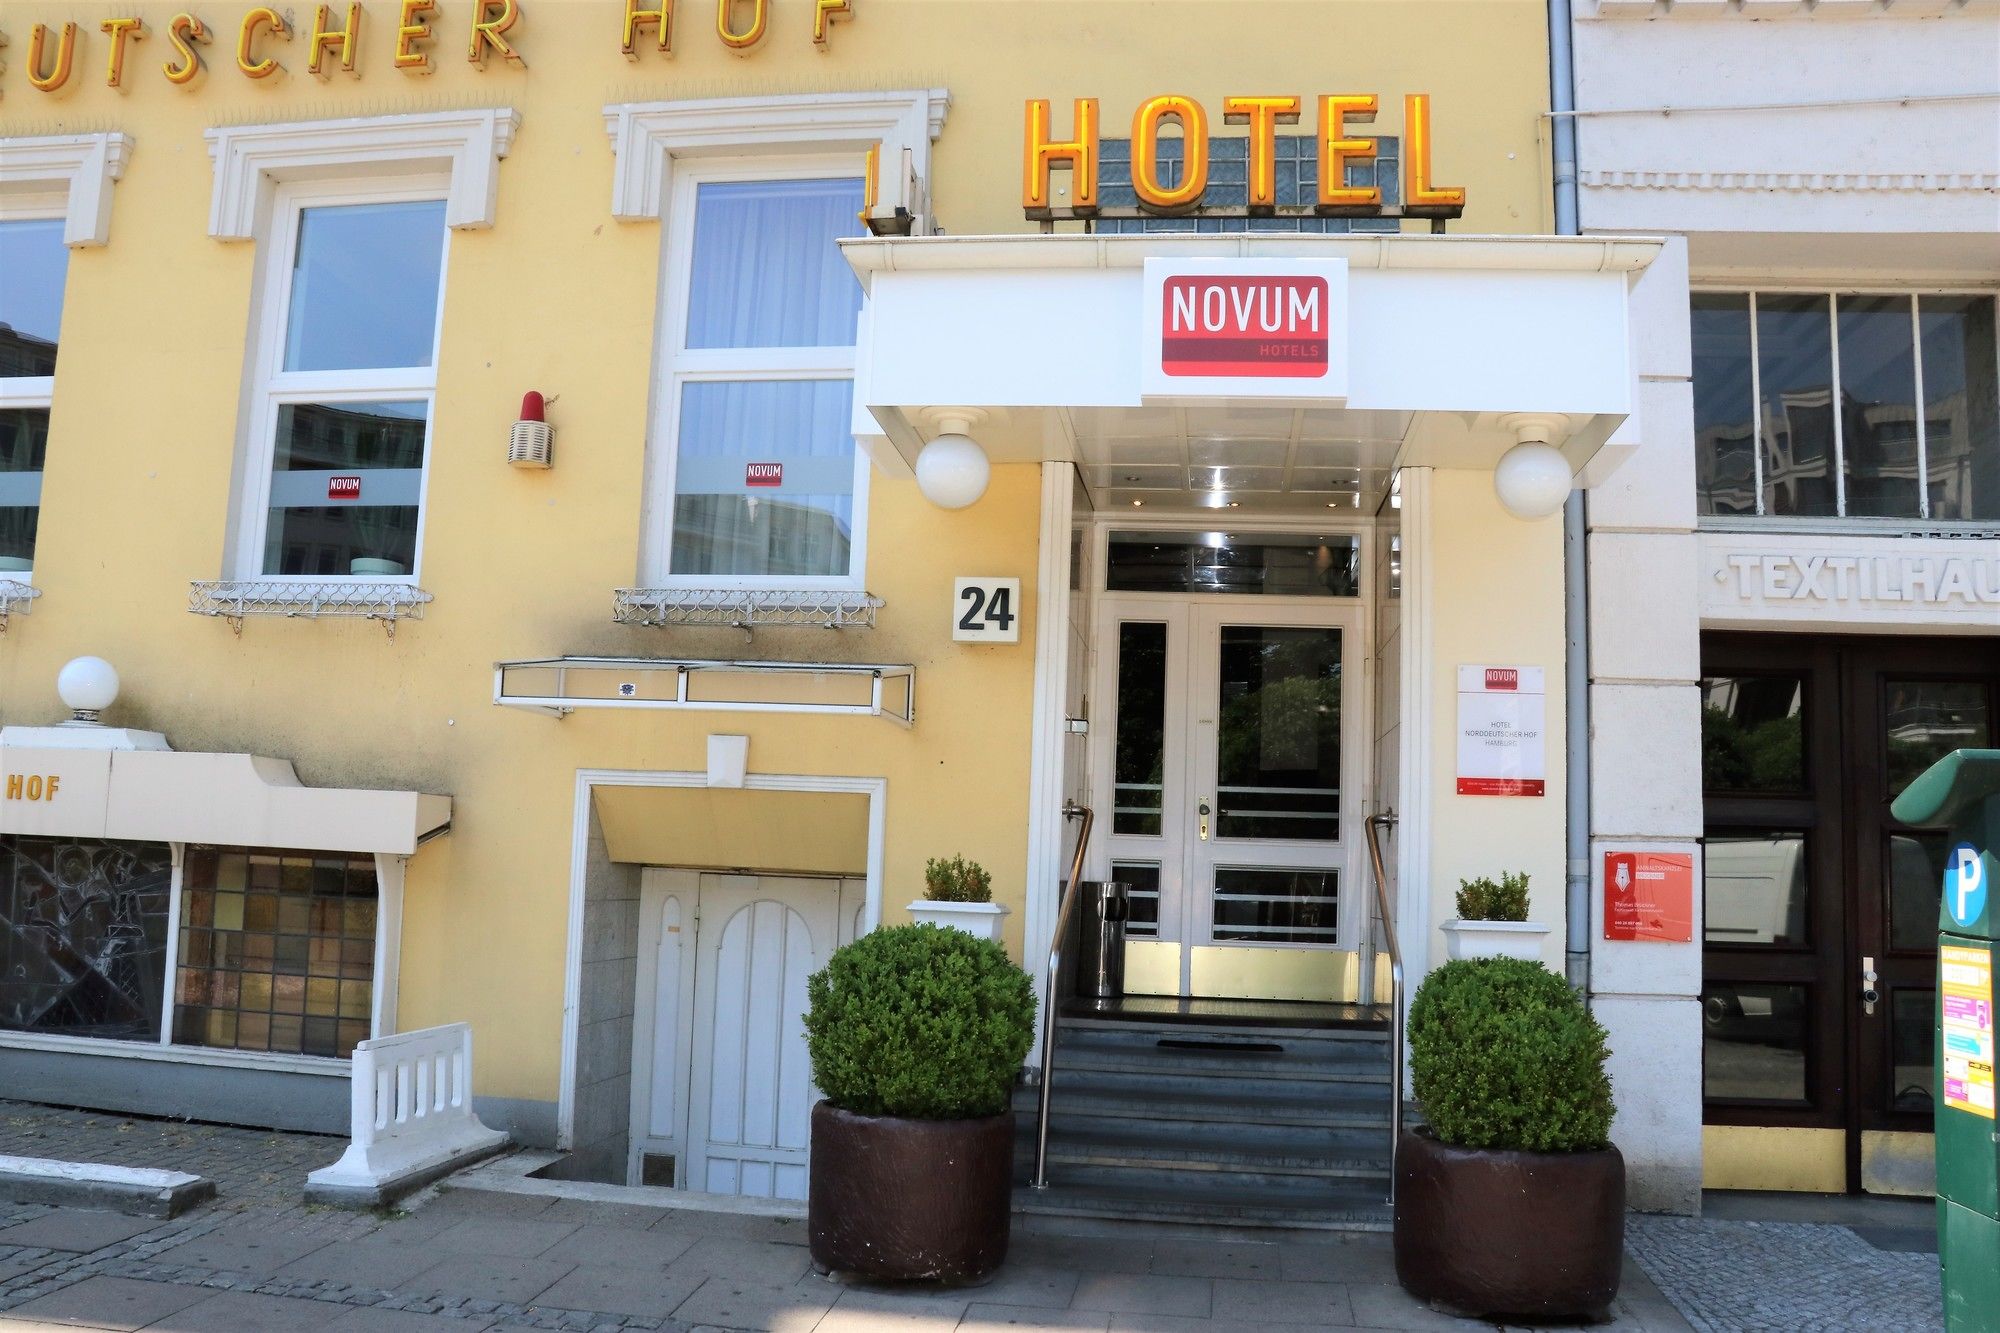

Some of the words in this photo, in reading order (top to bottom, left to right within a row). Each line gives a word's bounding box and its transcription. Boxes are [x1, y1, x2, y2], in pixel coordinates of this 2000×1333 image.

[0, 0, 528, 93] UTSCHER
[622, 0, 851, 53] HOF
[1023, 94, 1466, 215] HOTEL
[1172, 285, 1319, 333] NOVUM
[1260, 344, 1319, 357] HOTELS
[747, 465, 781, 477] NOVUM
[330, 478, 360, 490] NOVUM
[959, 586, 1015, 631] 24
[1486, 670, 1517, 682] NOVUM
[1491, 721, 1512, 729] HOTEL
[1523, 731, 1538, 739] HOF
[7, 774, 60, 801] HOF
[1957, 848, 1982, 920] P
